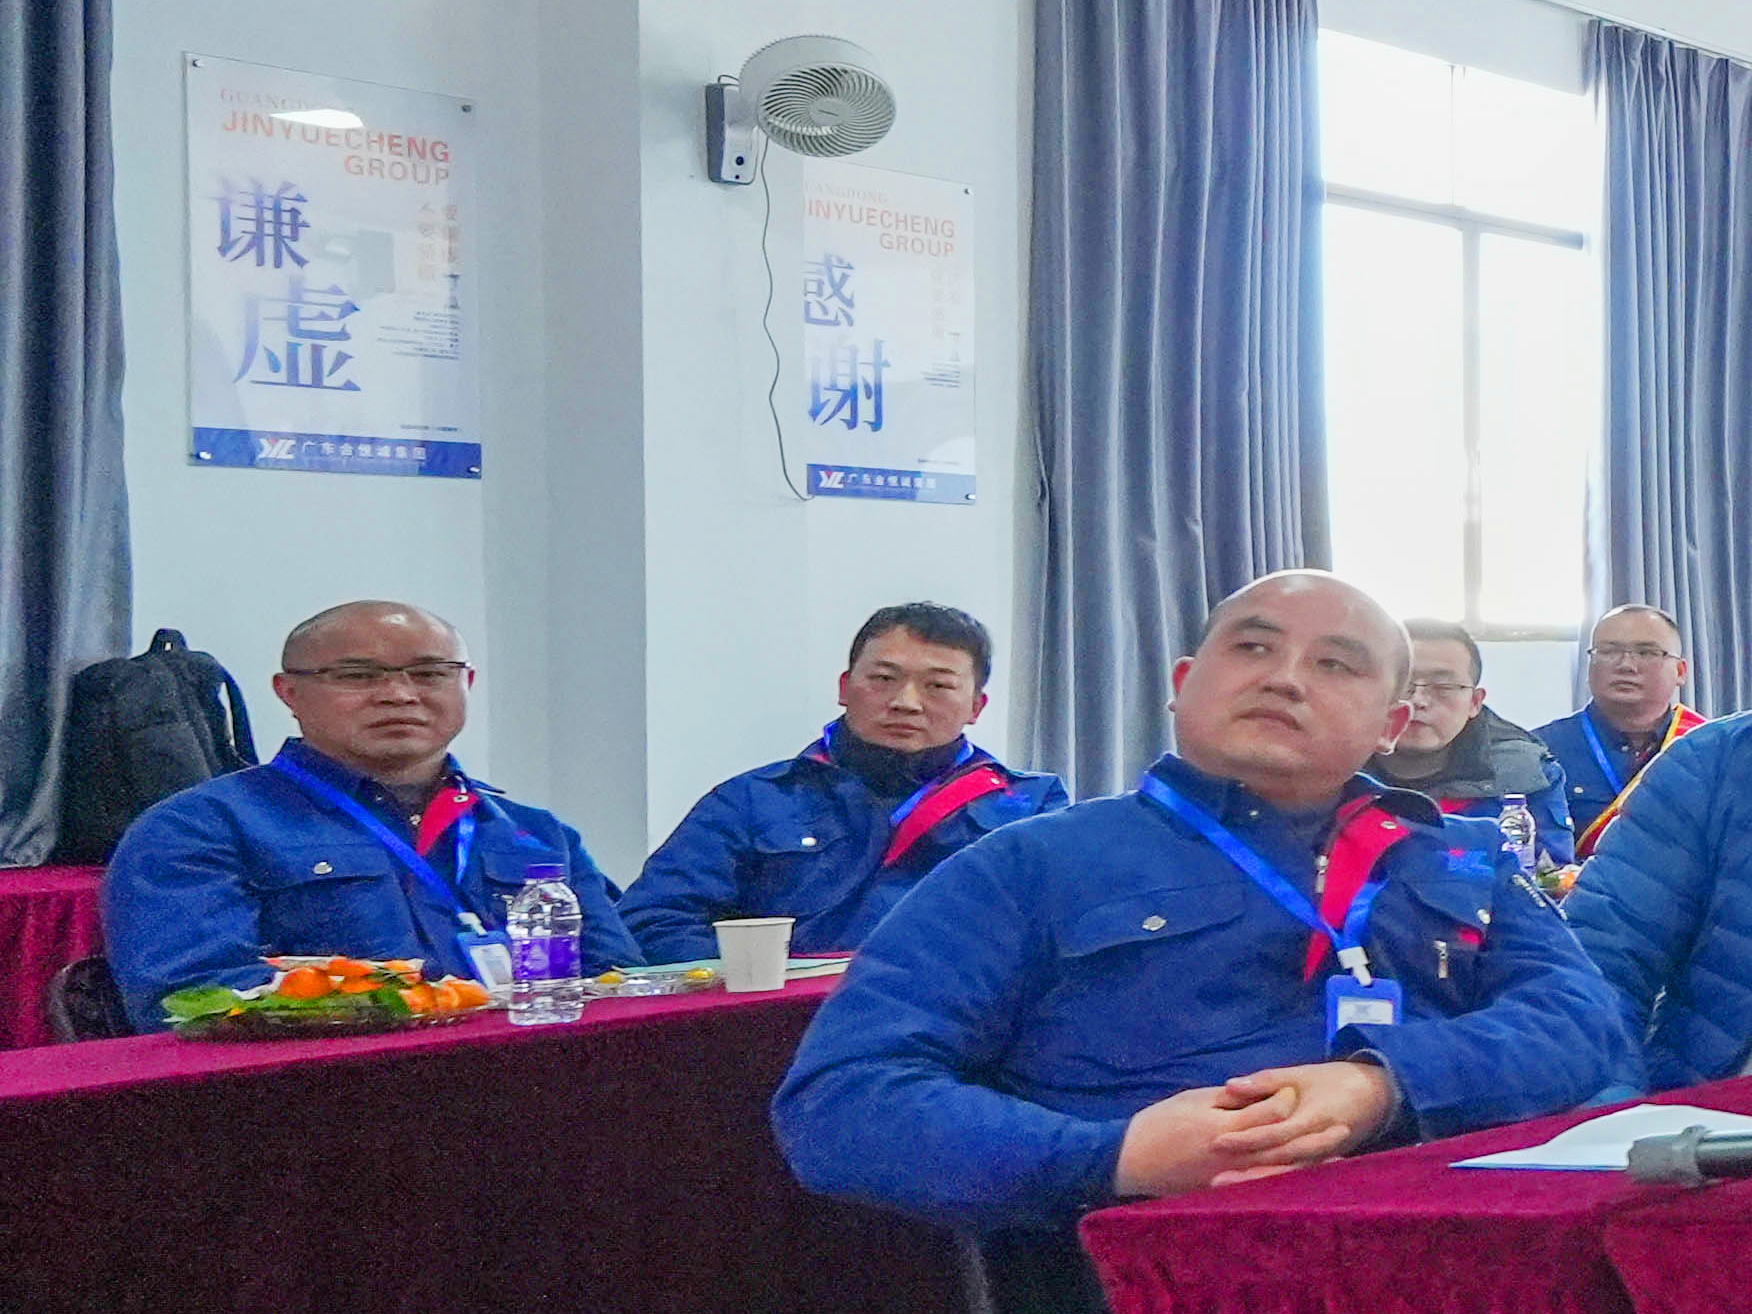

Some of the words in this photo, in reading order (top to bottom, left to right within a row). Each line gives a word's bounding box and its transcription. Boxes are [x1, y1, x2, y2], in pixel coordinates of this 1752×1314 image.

[344, 154, 449, 185] GROUP
[803, 196, 956, 238] INYUECHENG
[879, 232, 955, 258] GROUP
